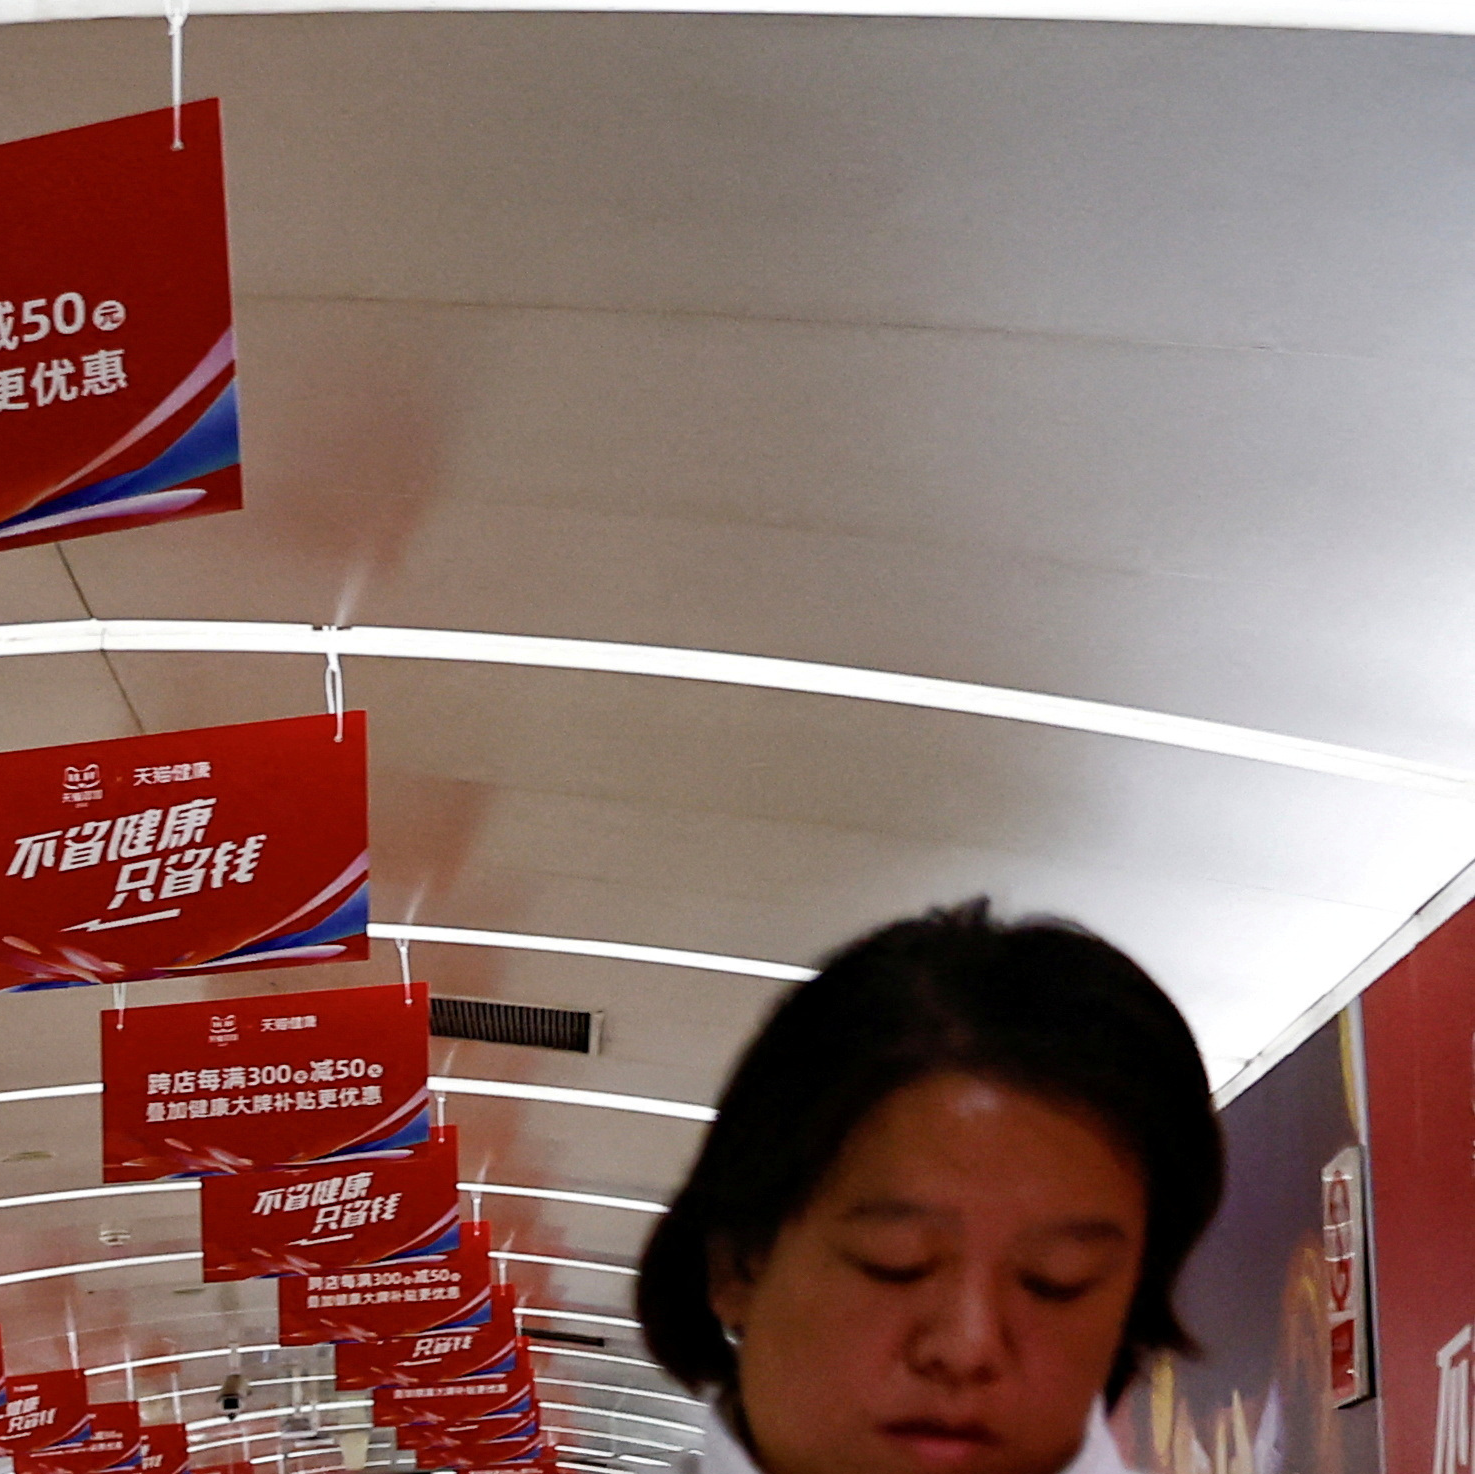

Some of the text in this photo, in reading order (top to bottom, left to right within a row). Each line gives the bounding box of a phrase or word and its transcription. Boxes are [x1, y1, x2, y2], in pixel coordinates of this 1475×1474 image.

[133, 761, 212, 786] 天猫健康
[5, 797, 217, 879] 不省健康
[106, 834, 267, 910] 只省钱
